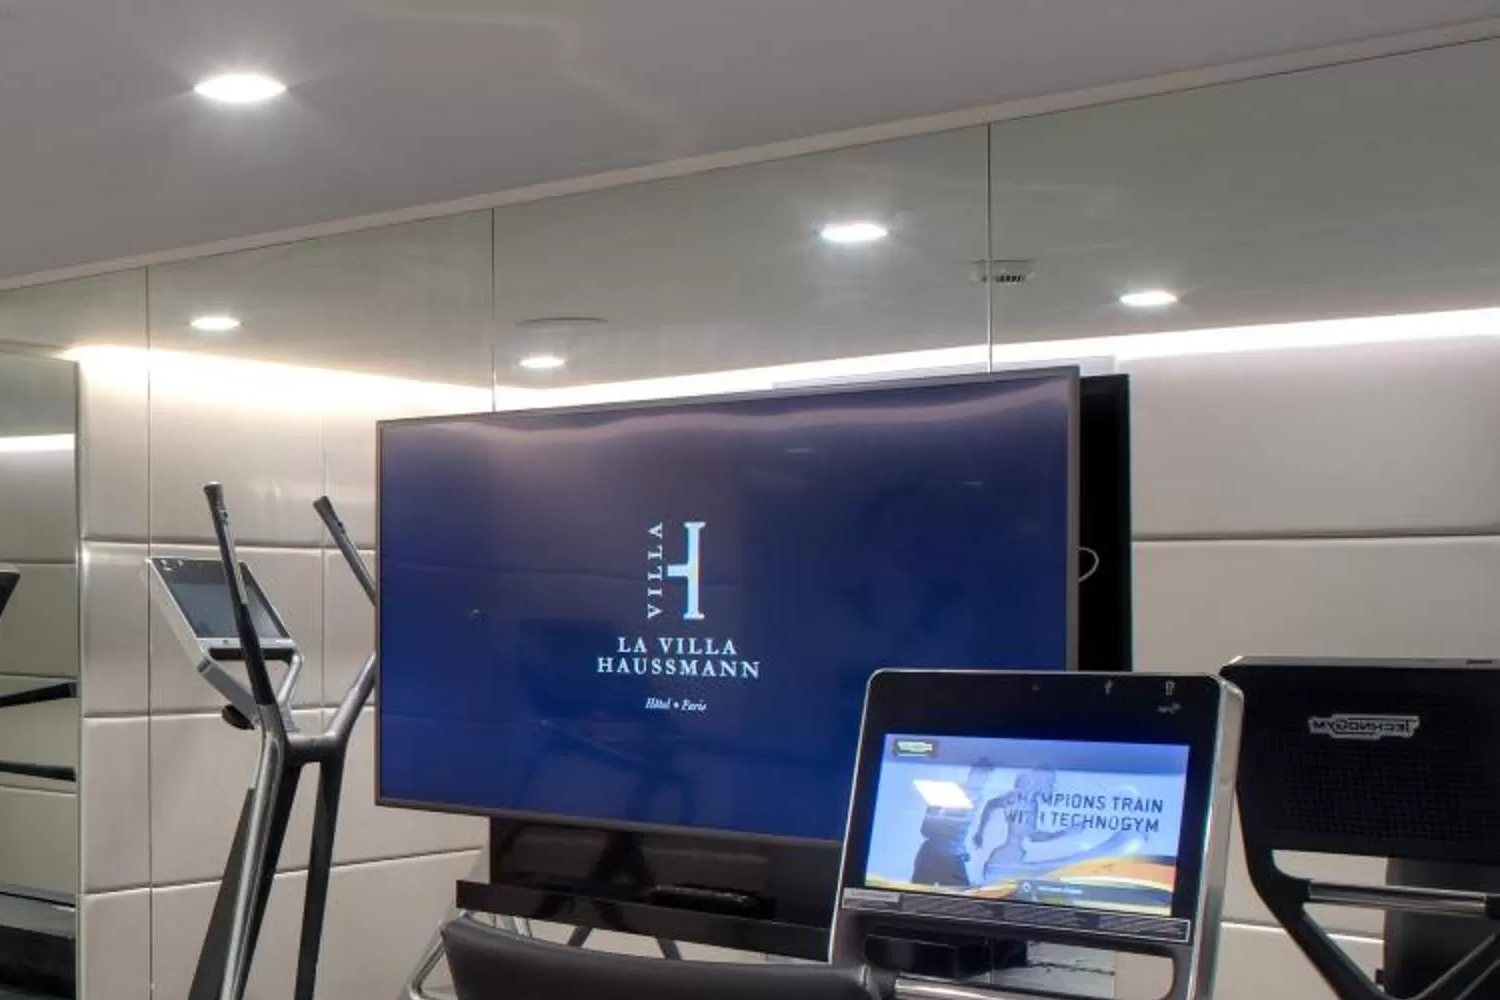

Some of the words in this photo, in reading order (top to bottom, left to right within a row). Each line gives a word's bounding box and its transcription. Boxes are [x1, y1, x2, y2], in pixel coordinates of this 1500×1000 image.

[647, 521, 664, 619] VILLA
[617, 636, 648, 654] LA
[659, 636, 738, 655] VILLA
[596, 656, 761, 680] HAUSSMANN
[681, 698, 707, 711] Paris
[1112, 794, 1164, 814] TRAIN
[1050, 811, 1160, 833] TECHNOGYM
